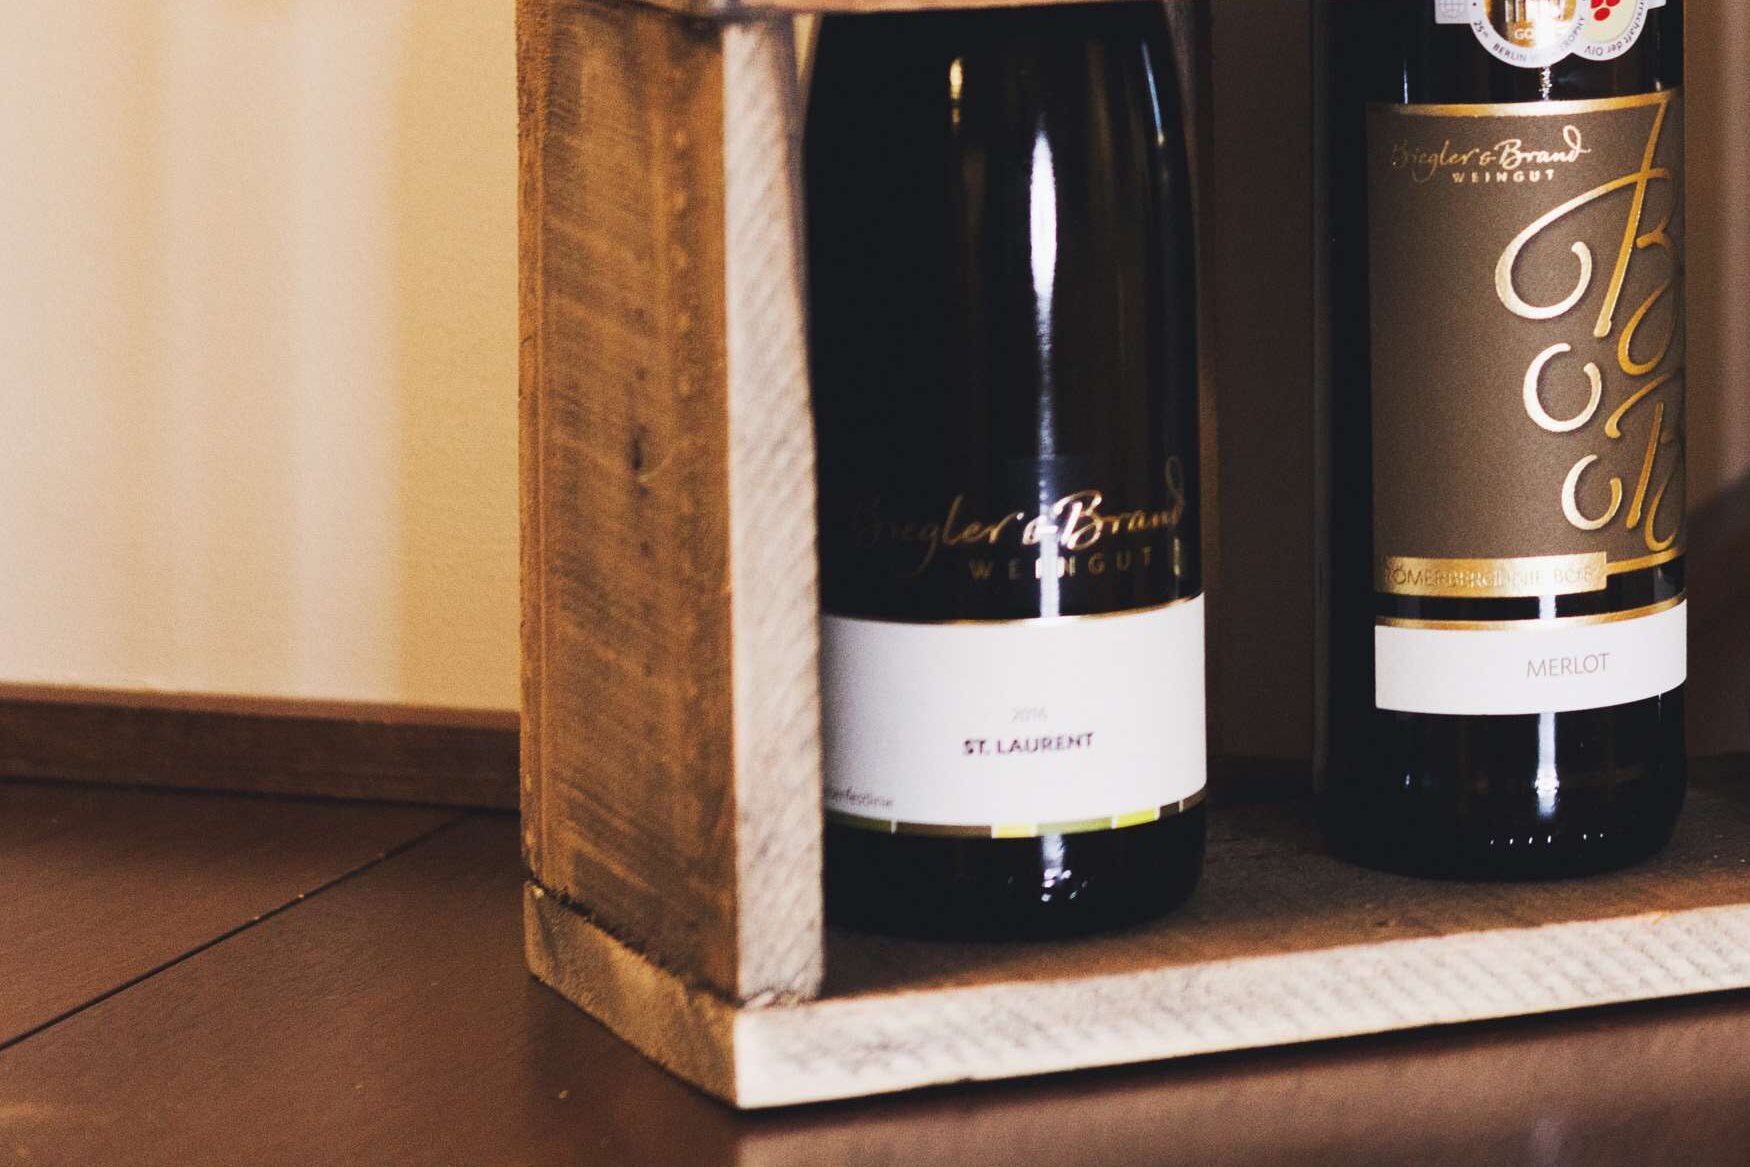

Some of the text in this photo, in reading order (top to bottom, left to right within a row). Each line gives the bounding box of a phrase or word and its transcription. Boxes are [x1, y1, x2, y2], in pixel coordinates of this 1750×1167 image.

[1491, 43, 1528, 63] BERLIN
[1607, 40, 1623, 54] der
[1493, 125, 1593, 171] Brand
[1452, 168, 1555, 184] WEINGUT
[1053, 455, 1185, 551] Brand
[970, 545, 1152, 580] WEINGUT
[1526, 652, 1610, 678] MERLOT
[963, 731, 1095, 756] ST. LAURENT
